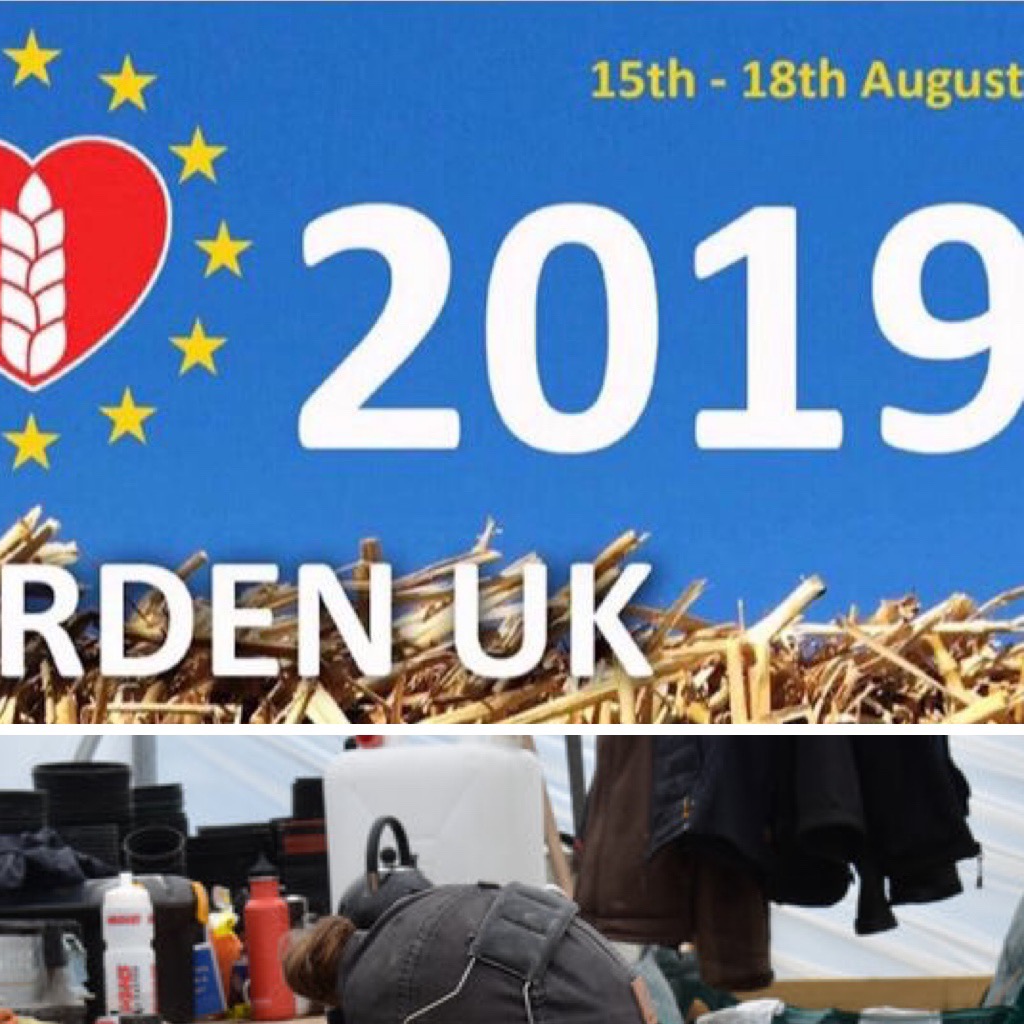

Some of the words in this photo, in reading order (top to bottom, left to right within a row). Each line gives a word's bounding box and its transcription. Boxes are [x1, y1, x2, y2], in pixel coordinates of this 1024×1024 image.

[590, 58, 696, 99] 15th
[743, 57, 847, 99] 18th
[861, 60, 1024, 109] August
[298, 203, 1024, 454] 2019
[452, 562, 654, 680] UK
